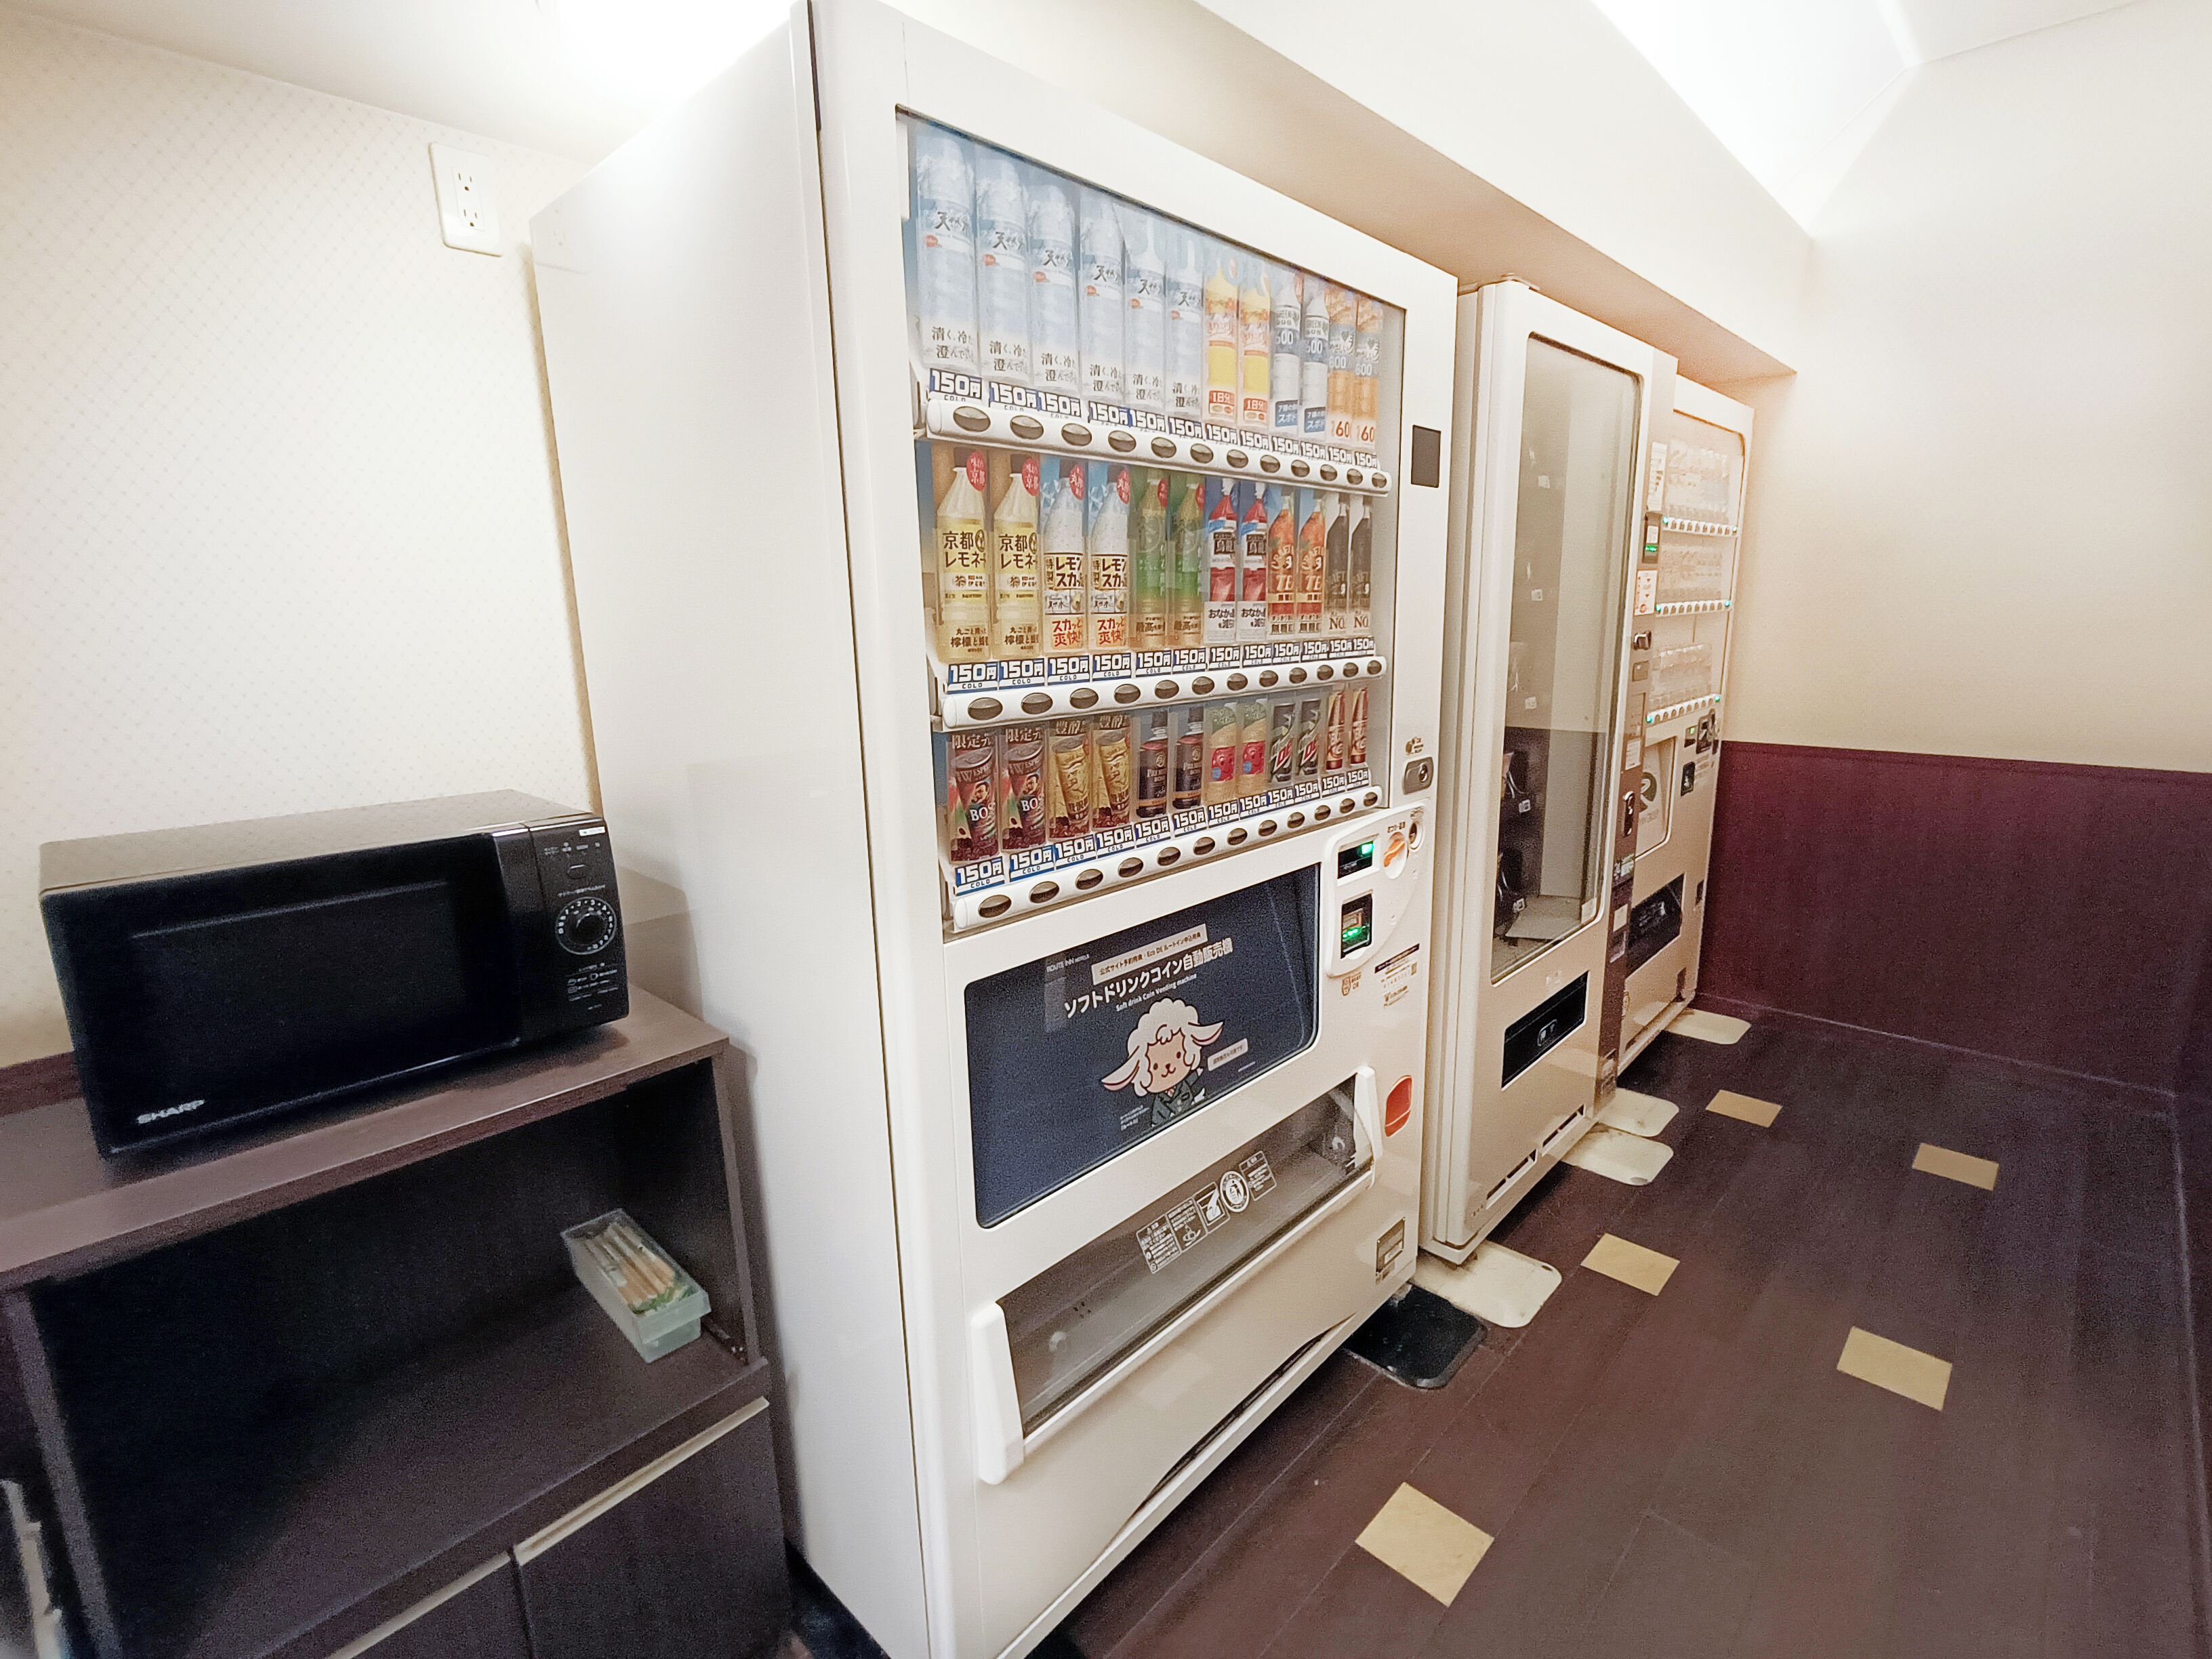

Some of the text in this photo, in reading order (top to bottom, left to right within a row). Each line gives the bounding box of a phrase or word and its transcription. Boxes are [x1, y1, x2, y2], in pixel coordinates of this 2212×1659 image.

[932, 370, 981, 398] 150円
[991, 382, 1038, 409] 150円
[1040, 392, 1081, 417] 150円
[1090, 403, 1128, 426] 150円
[1131, 410, 1166, 432] 150円
[1170, 418, 1202, 439] 150円
[1206, 426, 1237, 445] 150円
[1241, 431, 1269, 450] 150円
[1274, 437, 1300, 455] 150円
[1302, 443, 1326, 459] 150円
[1329, 447, 1352, 464] 150円
[1355, 452, 1377, 468] 150円
[943, 531, 973, 550] 京都
[999, 534, 1027, 552] 京都
[1245, 644, 1271, 659] 150円
[1275, 642, 1299, 657] 150円
[1304, 640, 1327, 654] 150円
[1330, 639, 1351, 652] 150円
[1354, 637, 1374, 649] 150円
[1094, 653, 1130, 671] 150円
[1139, 651, 1170, 668] 150円
[1175, 649, 1205, 665] 150円
[1212, 647, 1240, 662] 150円
[951, 663, 996, 683] 150円
[1001, 660, 1043, 680] 150円
[1049, 657, 1088, 675] 150円
[1323, 776, 1345, 790] 150円
[1348, 769, 1368, 781] 150円
[1269, 788, 1293, 804] 150円
[1295, 782, 1318, 798] 150円
[1209, 801, 1237, 820] 150円
[1241, 793, 1267, 811] 150円
[1174, 810, 1205, 829] 150円
[1183, 824, 1197, 832] COLD
[1097, 827, 1133, 848] 150円
[1136, 819, 1170, 840] 150円
[1145, 834, 1160, 842] COLD
[1056, 838, 1095, 859] 150円
[1107, 844, 1124, 852] COLD
[1011, 850, 1053, 871] 150円
[1067, 855, 1084, 863] COLD
[958, 861, 1002, 885] 150円
[1023, 865, 1040, 874] COLD
[970, 879, 990, 888] COLD
[1064, 937, 1233, 1019] ソフトドリンクコイン自動販売機
[1115, 1001, 1128, 1012] Soft
[1128, 995, 1143, 1008] drink
[1143, 990, 1155, 1001] Coin
[1155, 981, 1177, 996] Vending
